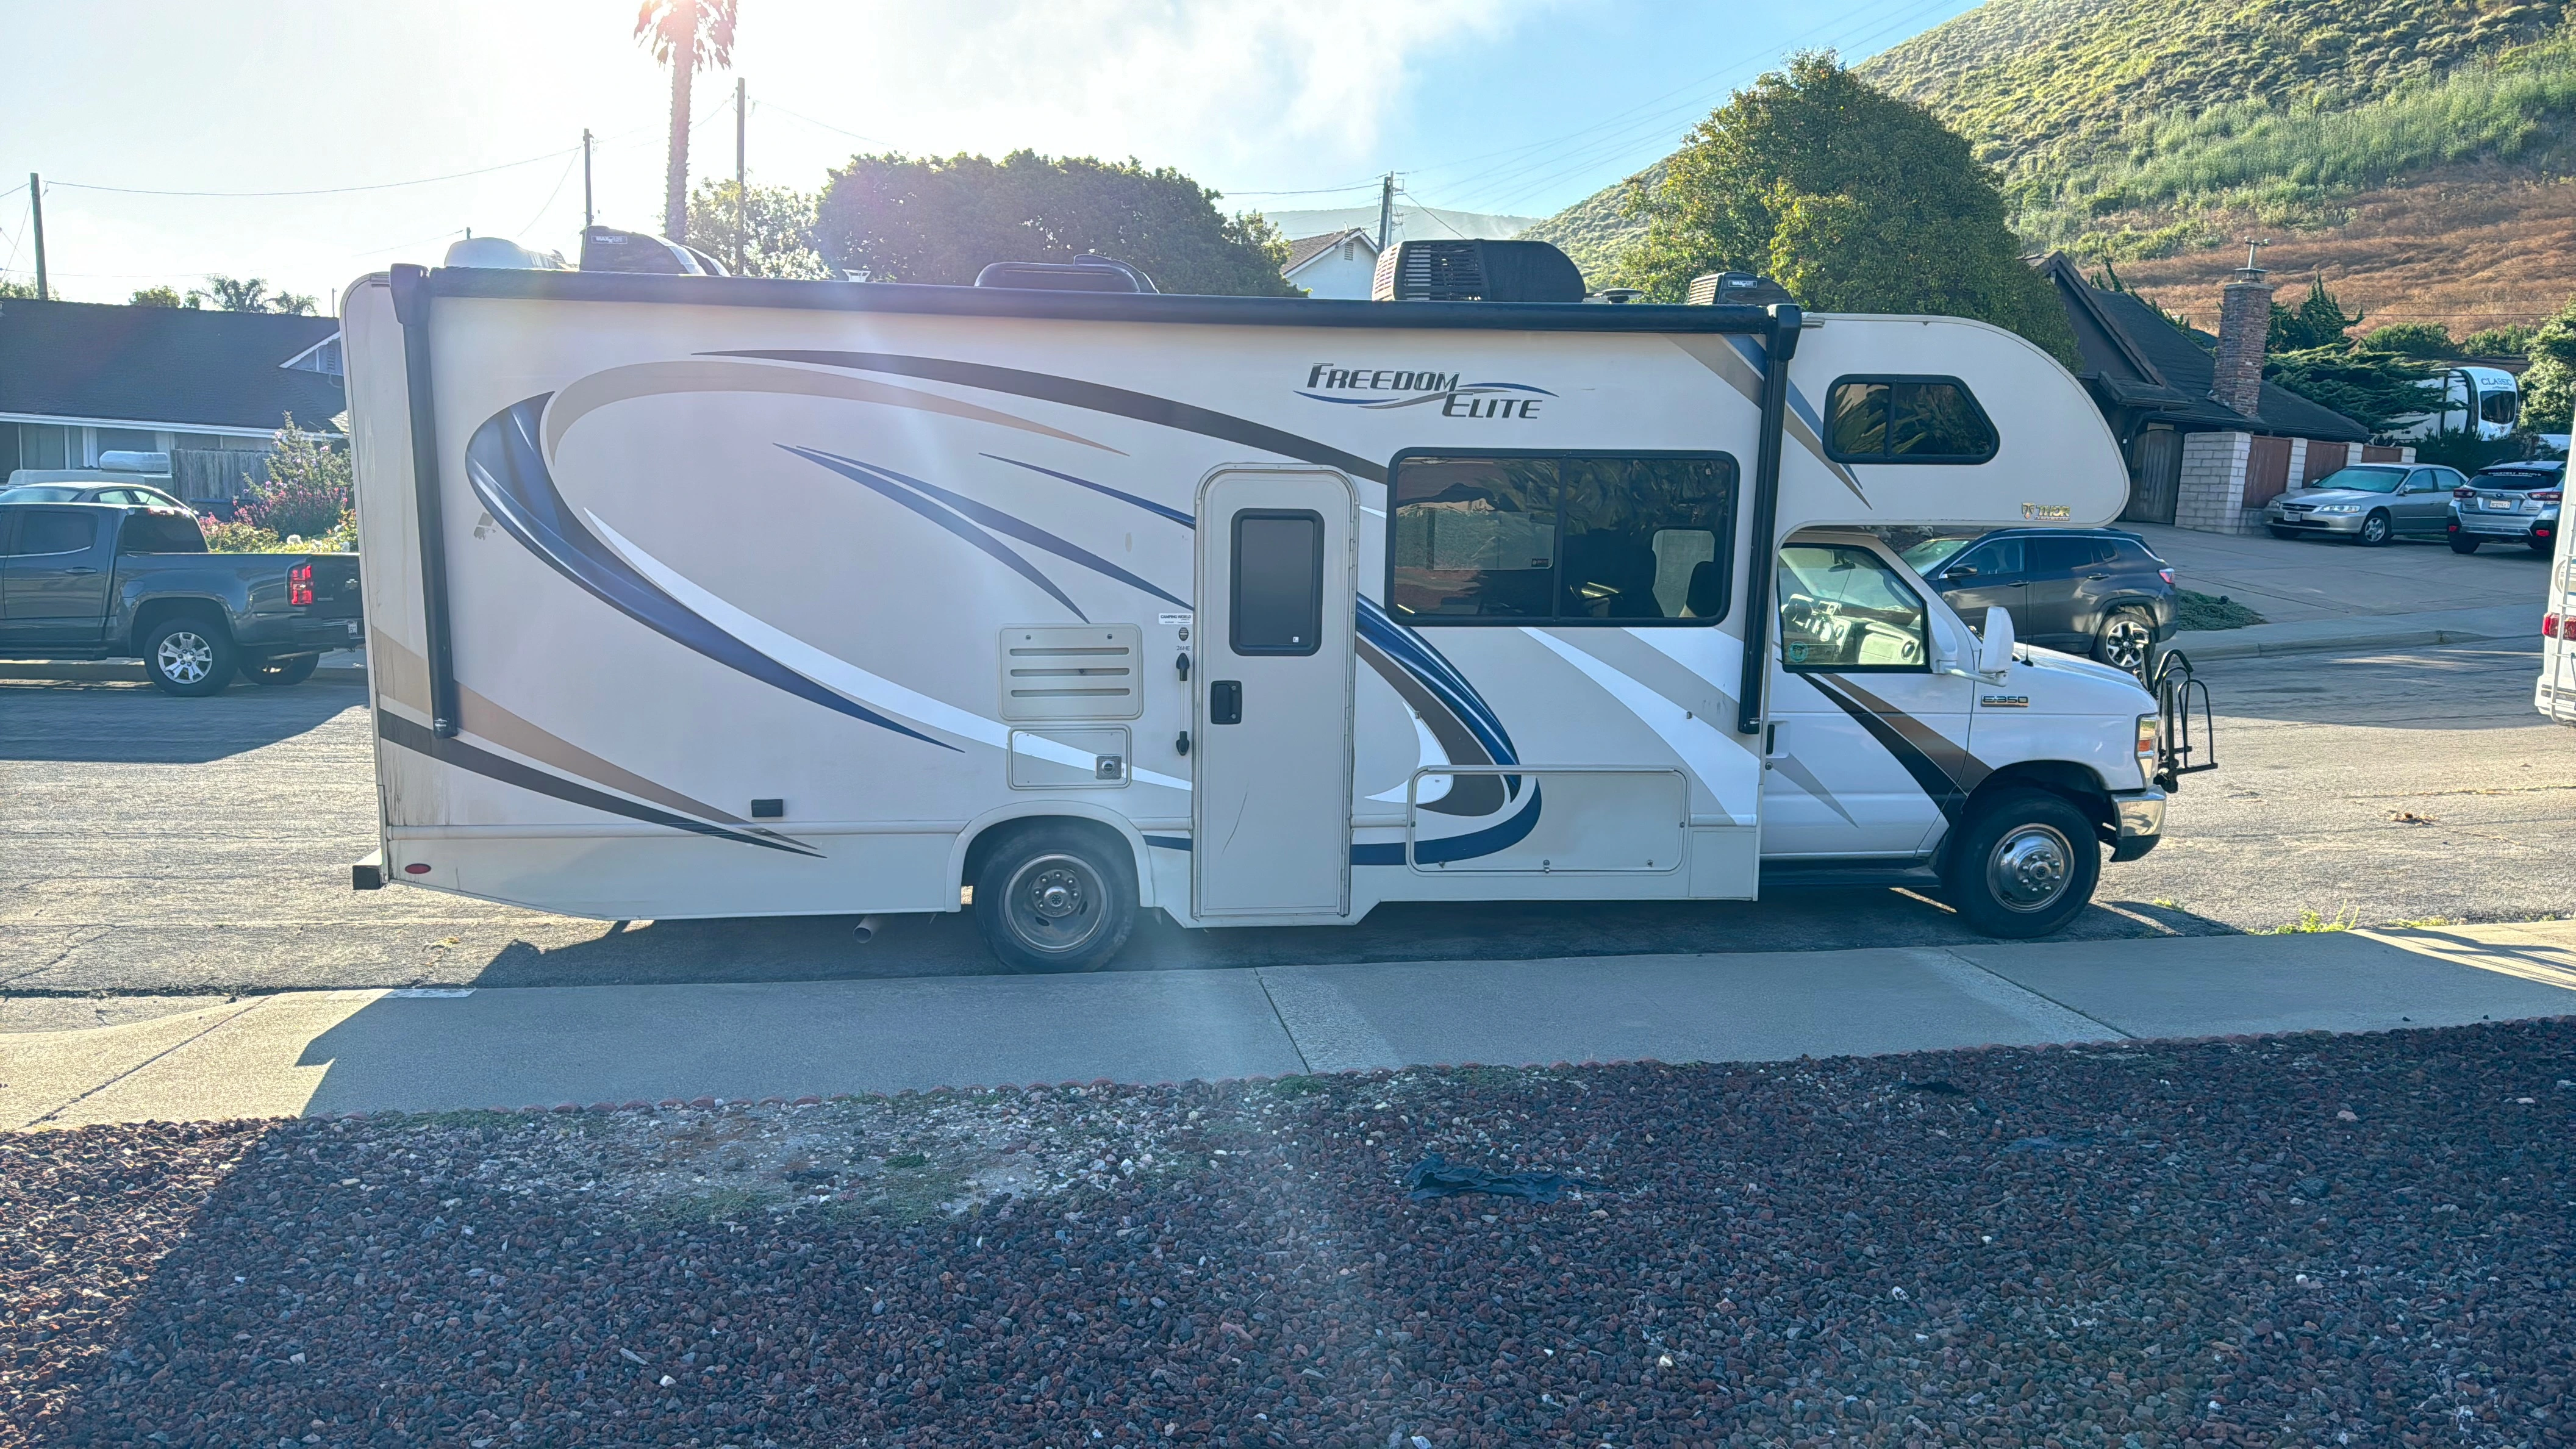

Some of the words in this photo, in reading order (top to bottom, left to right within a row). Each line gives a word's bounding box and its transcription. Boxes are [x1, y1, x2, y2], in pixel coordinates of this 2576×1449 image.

[1306, 363, 1460, 392] FREEDOM
[1442, 392, 1543, 419] ELITE
[2036, 505, 2070, 517] THOR
